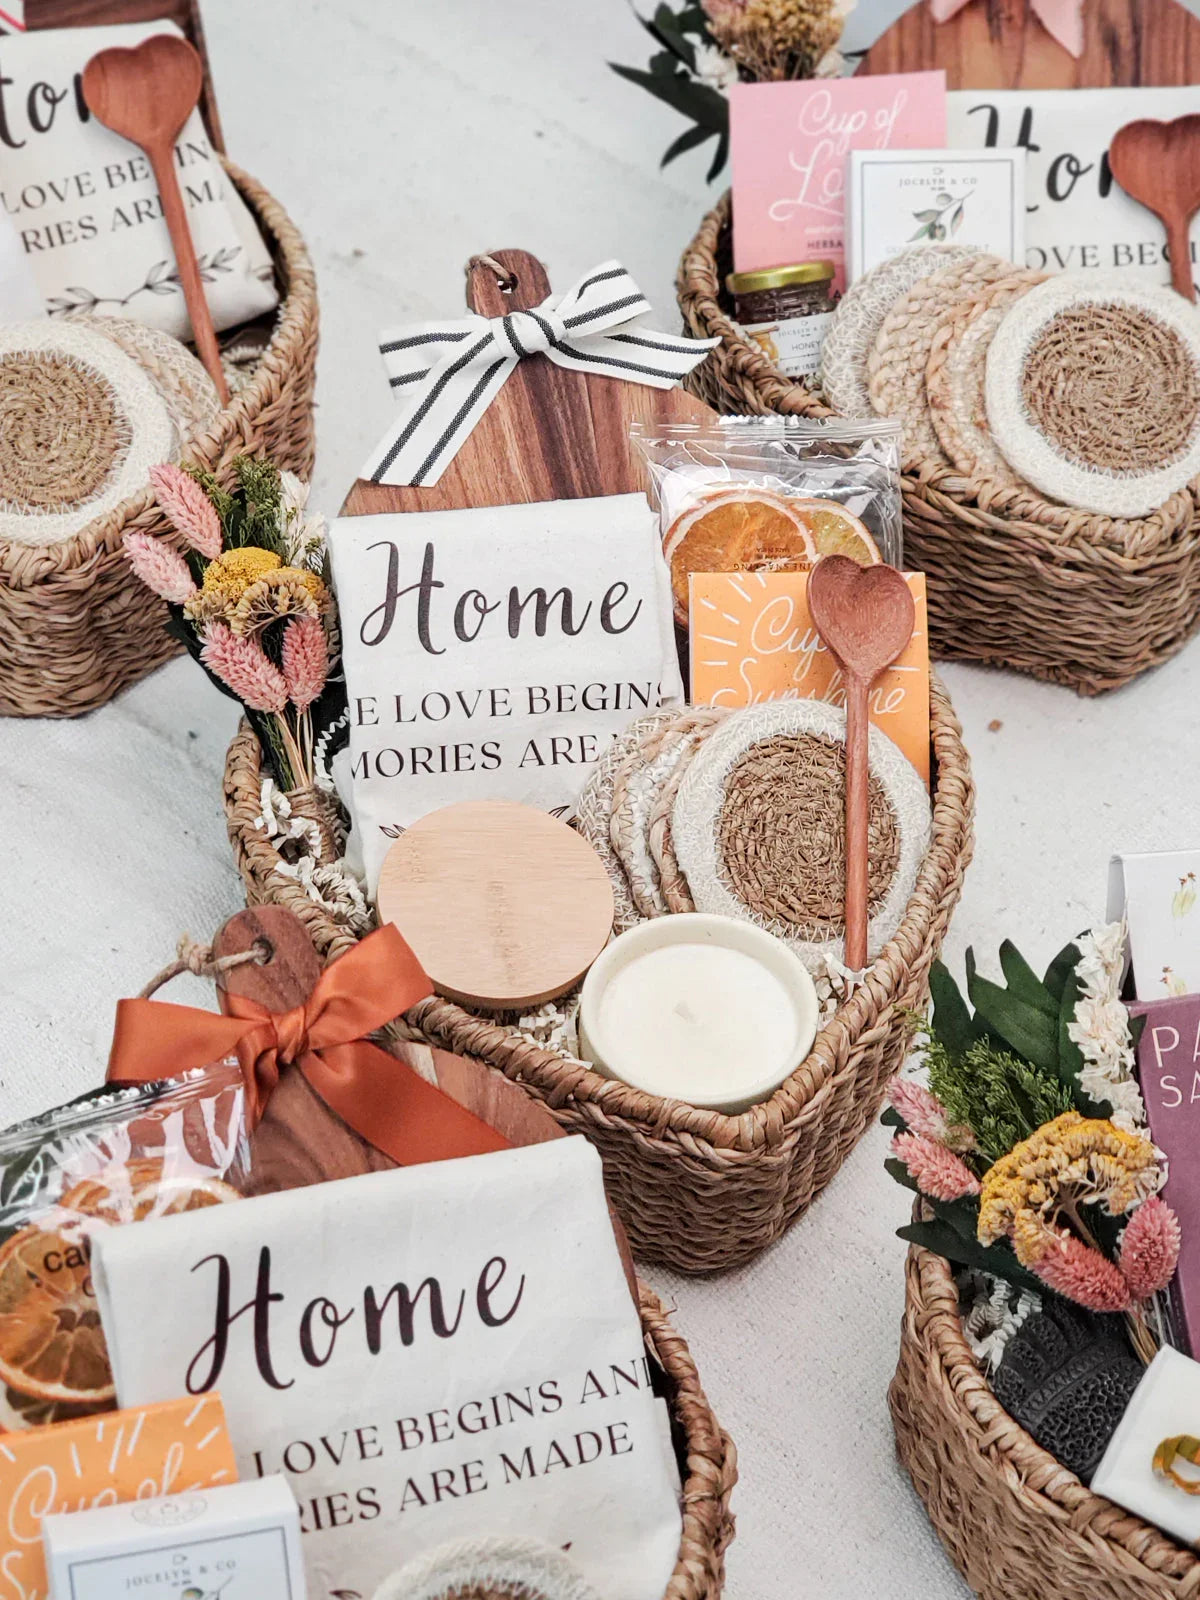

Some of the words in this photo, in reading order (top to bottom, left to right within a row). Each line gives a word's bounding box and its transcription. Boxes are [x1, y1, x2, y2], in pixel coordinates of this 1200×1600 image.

[799, 89, 867, 156] Cup
[768, 139, 844, 221] Lo
[899, 178, 945, 187] JOCELYN
[807, 239, 843, 249] HERBA
[791, 341, 820, 351] HONEY
[360, 541, 643, 655] Home
[394, 688, 513, 724] LOVE
[518, 734, 600, 768] ARE
[185, 1246, 525, 1395] Home
[253, 1425, 384, 1480] LOVE
[396, 1379, 564, 1453] BEGINS
[399, 1459, 489, 1513] ARE
[499, 1421, 635, 1485] MADE
[126, 1568, 190, 1589] JOCELYN
[216, 1560, 237, 1571] CO
